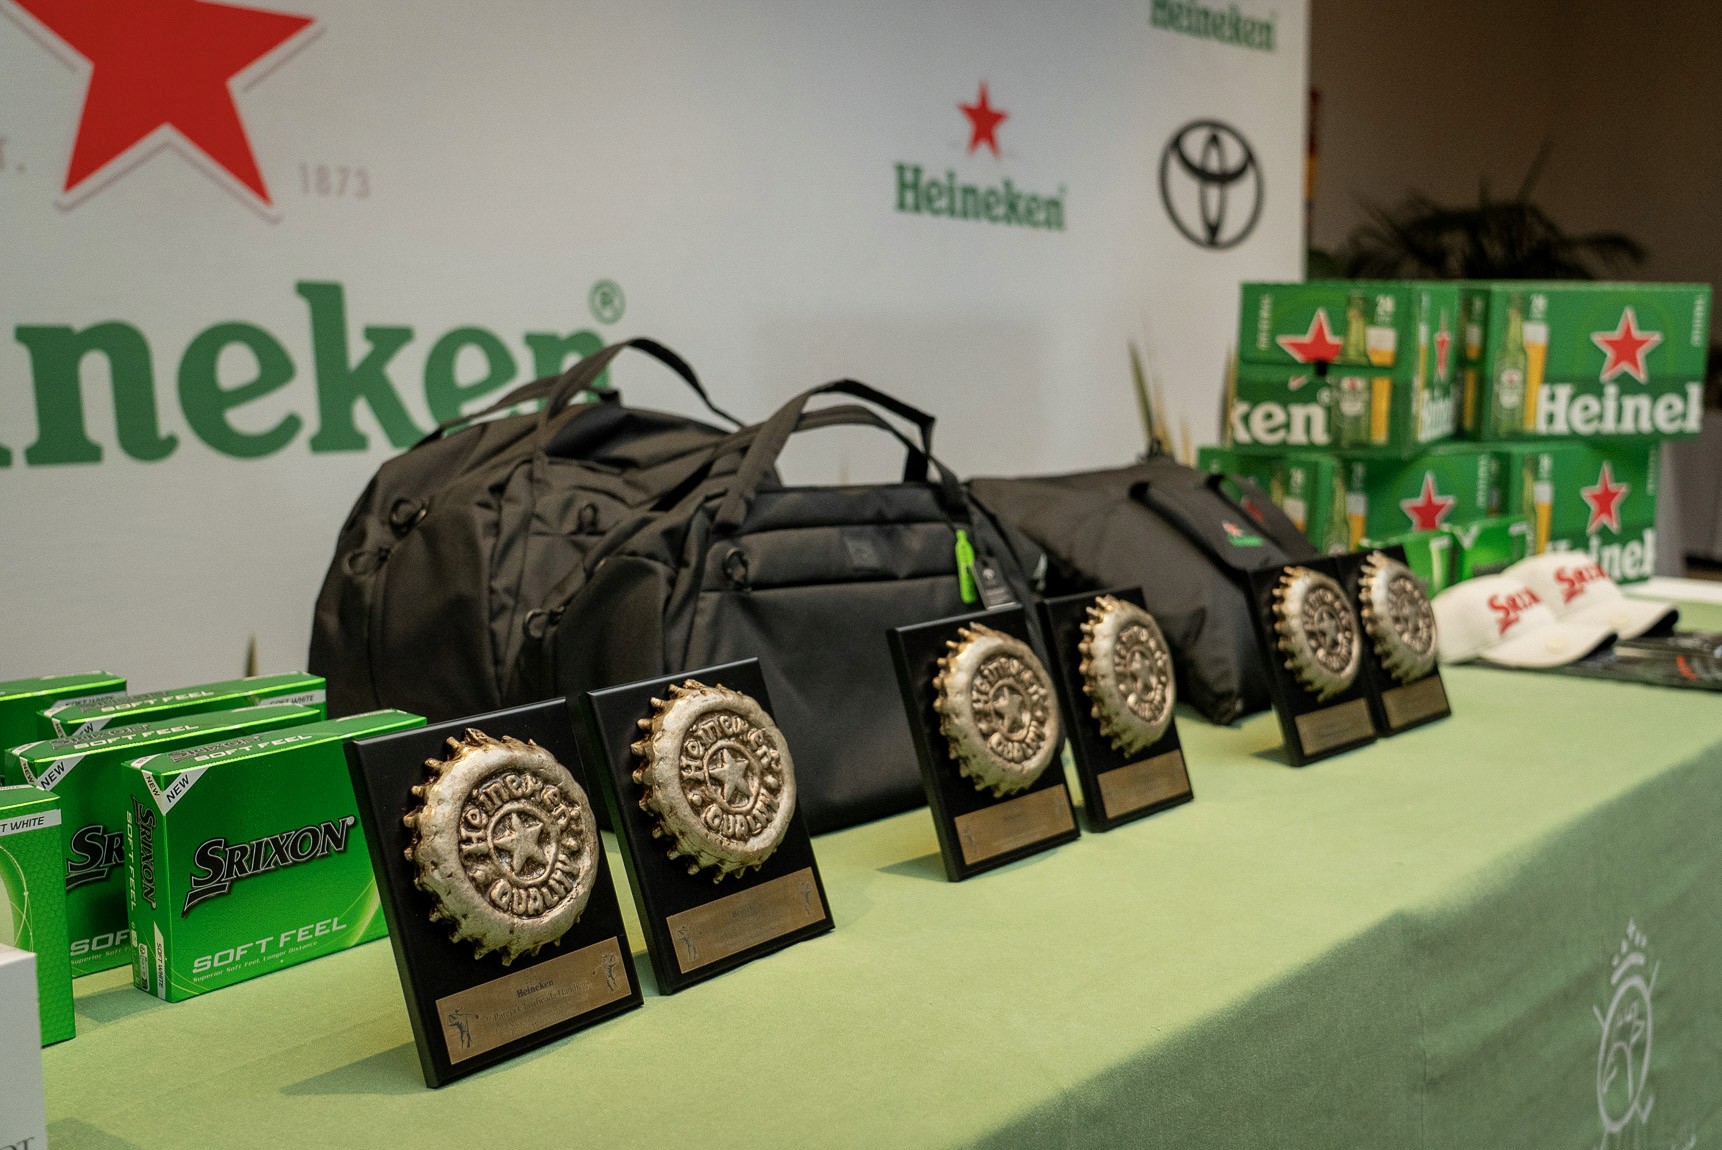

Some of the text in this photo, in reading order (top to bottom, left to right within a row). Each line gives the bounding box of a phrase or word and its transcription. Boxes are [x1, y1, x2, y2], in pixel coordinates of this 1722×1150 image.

[894, 162, 1066, 231] Heineken
[0, 281, 611, 466] neken
[194, 734, 312, 762] SOFT FEEL
[22, 763, 35, 783] NEW
[41, 762, 66, 790] NEW
[147, 776, 160, 797] NEW
[166, 774, 190, 803] NEW
[10, 816, 45, 831] WHITE
[126, 810, 137, 911] SOFT FEEL
[134, 796, 156, 909] SRIXON
[183, 815, 355, 915] SRIXON
[193, 917, 347, 974] SOFT FEEL
[193, 970, 224, 983] Superior
[226, 963, 242, 973] Soft
[263, 951, 287, 962] Longer
[288, 941, 318, 954] Distance
[516, 979, 554, 998] Heineken
